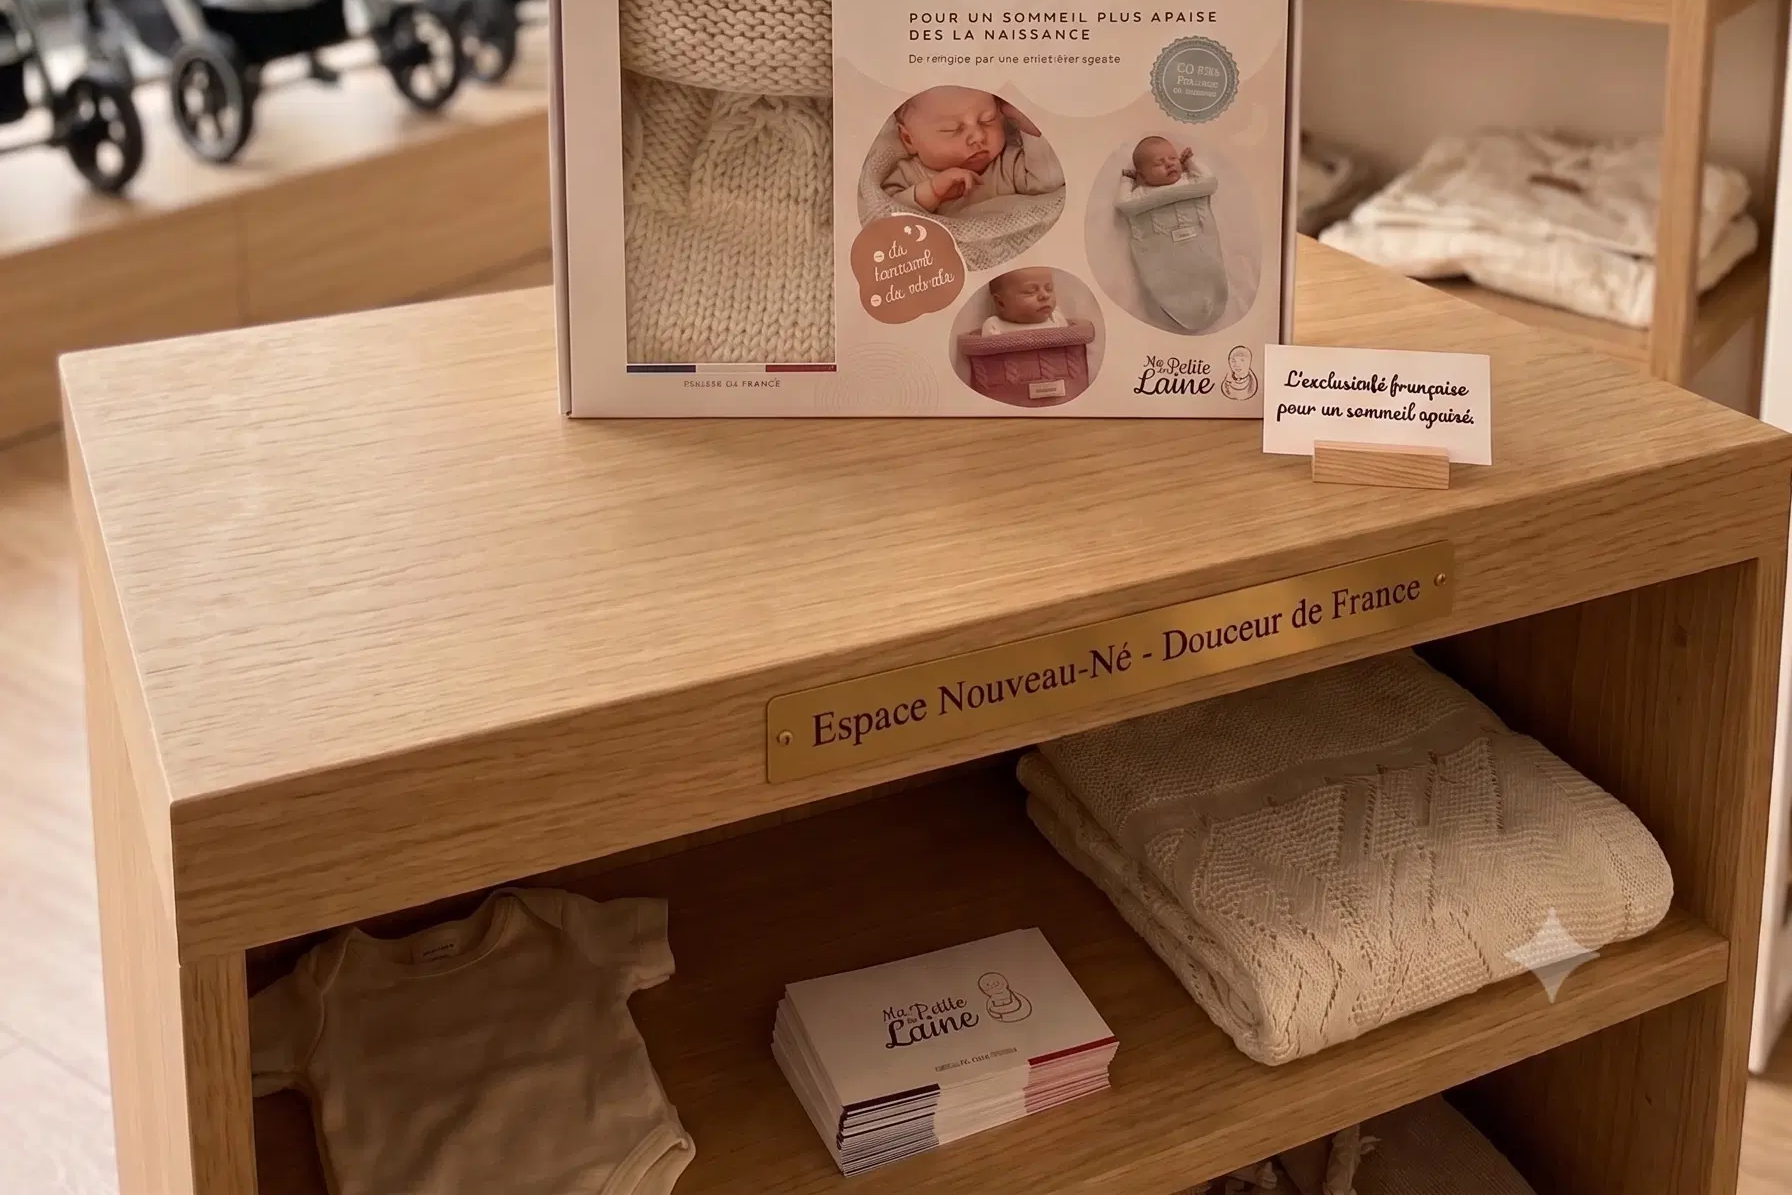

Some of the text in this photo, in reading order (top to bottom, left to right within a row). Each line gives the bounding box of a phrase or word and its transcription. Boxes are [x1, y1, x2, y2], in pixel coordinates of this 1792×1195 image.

[909, 11, 1218, 24] POUR UN SOMMEIL PLUS APAISE
[909, 28, 1091, 41] DES LA NAISSANCE
[908, 54, 924, 64] De
[975, 55, 995, 66] par
[998, 56, 1019, 64] une
[1133, 368, 1216, 395] Laine
[1276, 403, 1317, 422] pour
[1321, 406, 1343, 417] un
[1346, 402, 1417, 421] sommeil
[812, 697, 928, 747] Espace
[937, 642, 1132, 716] Nouveau-Né
[1161, 612, 1283, 661] Douceur
[1291, 598, 1322, 629] de
[1331, 580, 1421, 620] France
[885, 1011, 980, 1049] Laine
